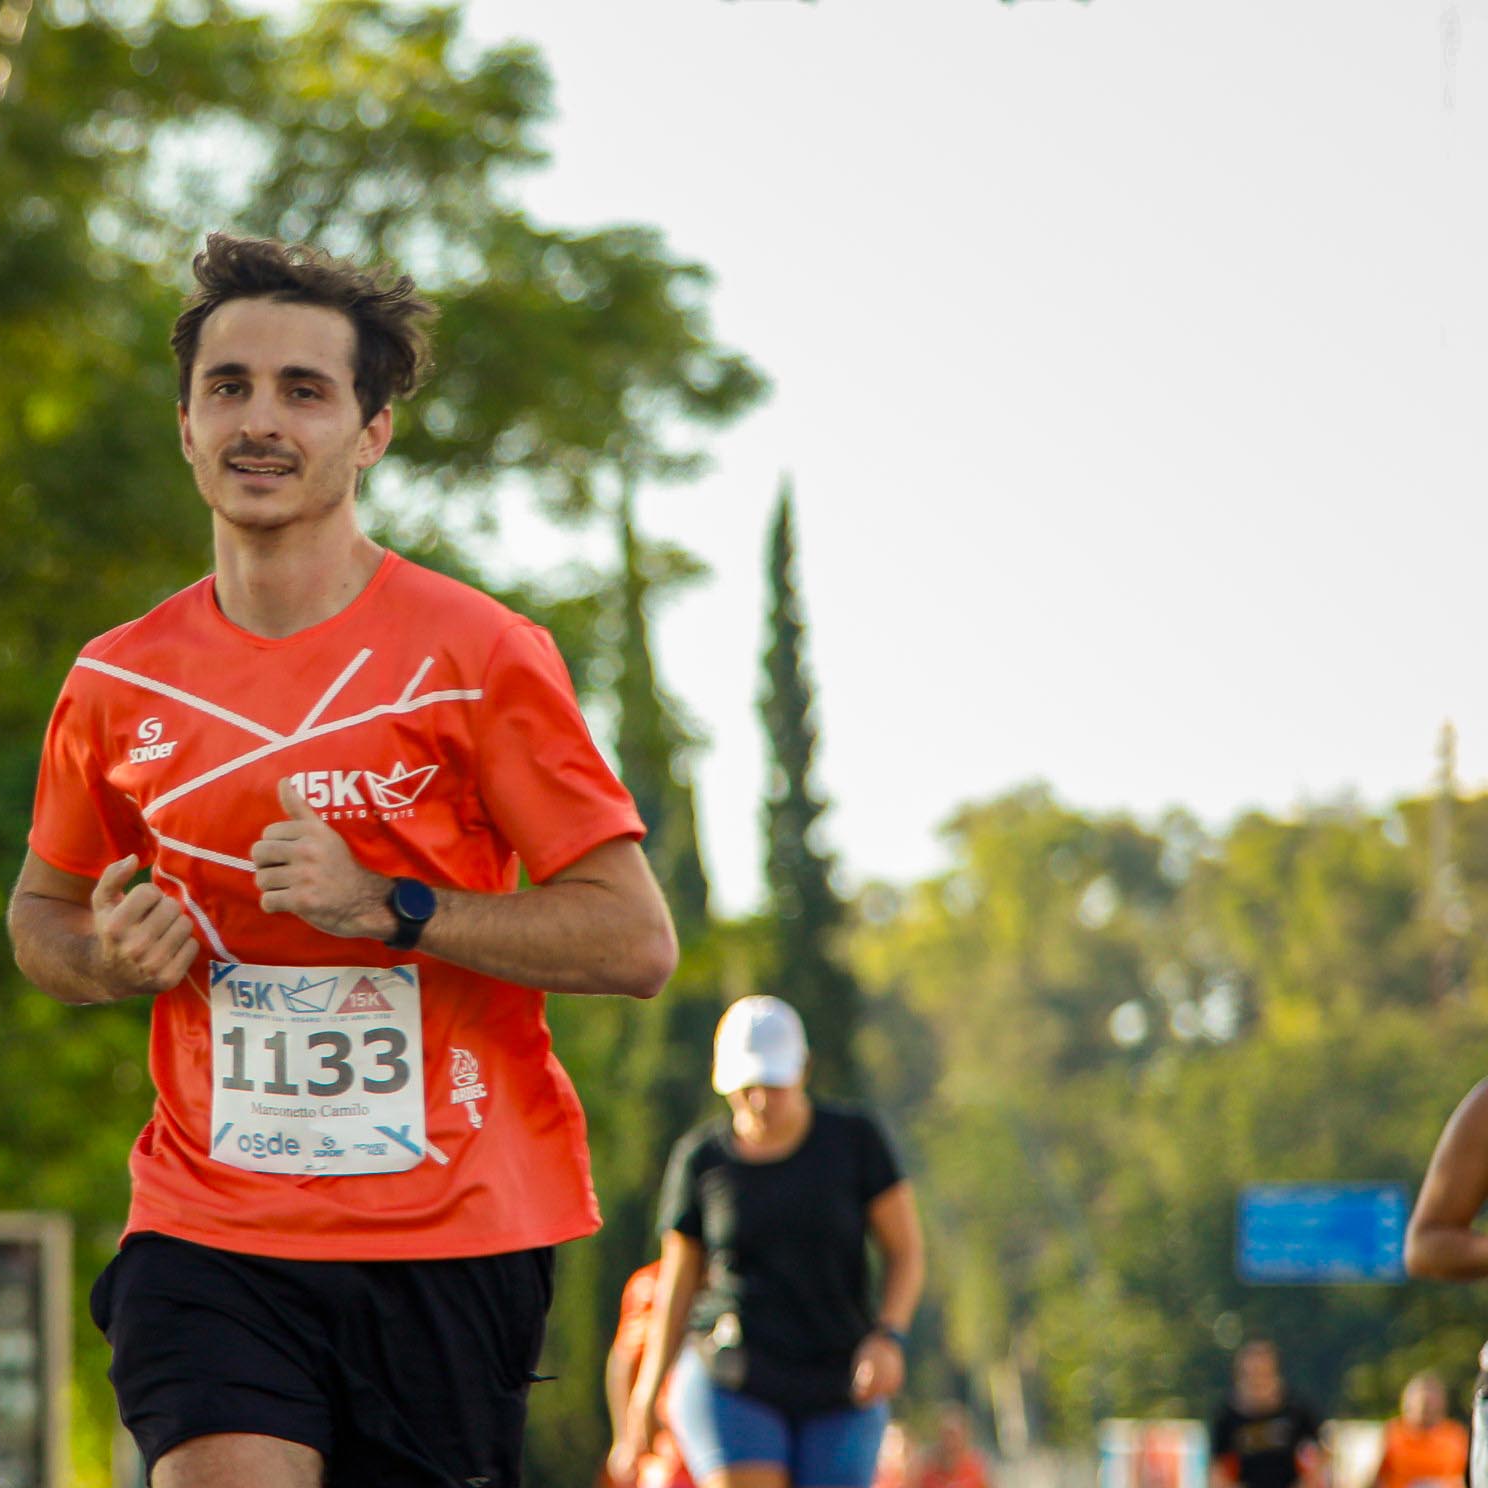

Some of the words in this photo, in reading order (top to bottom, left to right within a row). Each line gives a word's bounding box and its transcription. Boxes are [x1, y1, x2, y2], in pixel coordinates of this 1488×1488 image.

[290, 770, 366, 808] 15K
[321, 810, 366, 820] ERTO
[227, 980, 275, 1011] 15K
[349, 992, 381, 1008] 15K
[222, 1026, 410, 1097] 1133
[238, 1131, 301, 1157] osde
